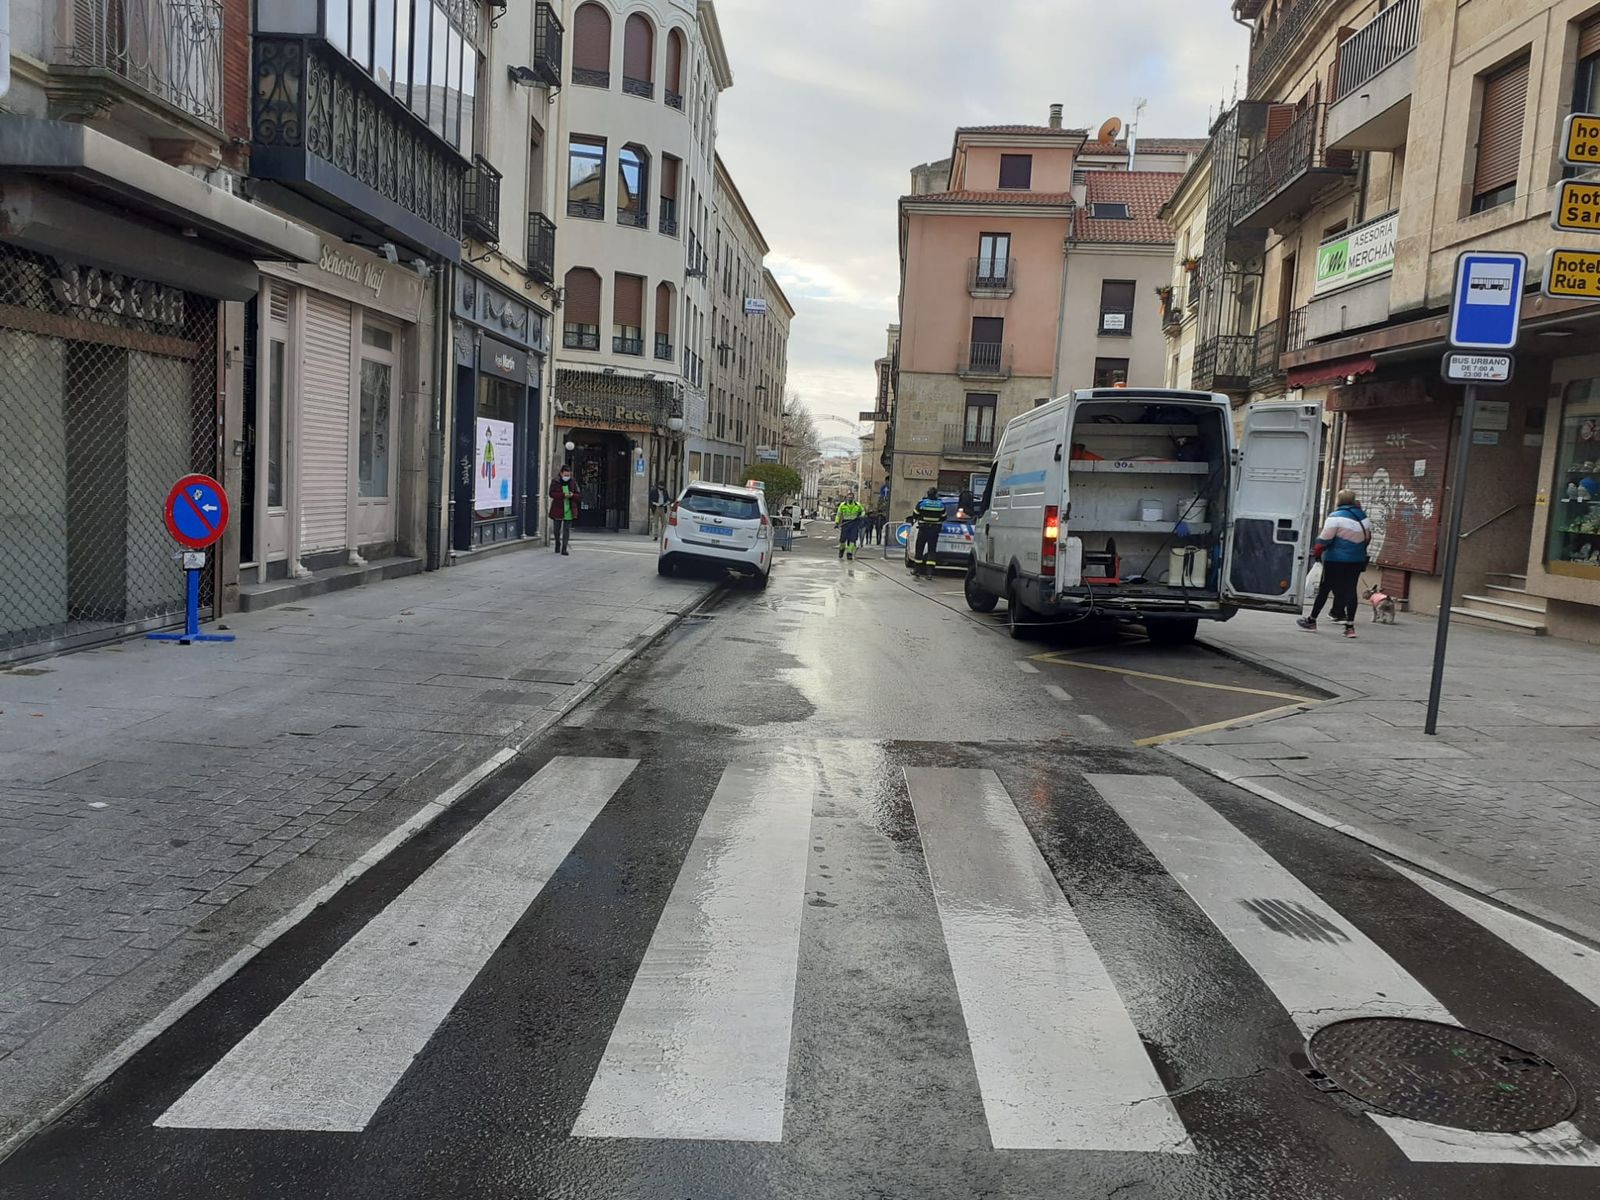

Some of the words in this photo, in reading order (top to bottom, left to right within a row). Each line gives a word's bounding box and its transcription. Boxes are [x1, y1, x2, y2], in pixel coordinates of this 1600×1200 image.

[1575, 142, 1598, 157] de
[320, 244, 361, 283] Señorita
[1557, 257, 1600, 274] hotel
[1555, 274, 1587, 290] Rúa
[1452, 357, 1470, 365] BUS
[1471, 358, 1507, 366] URBANO
[562, 400, 601, 418] Casa
[614, 405, 651, 422] Paca
[947, 526, 961, 535] 112
